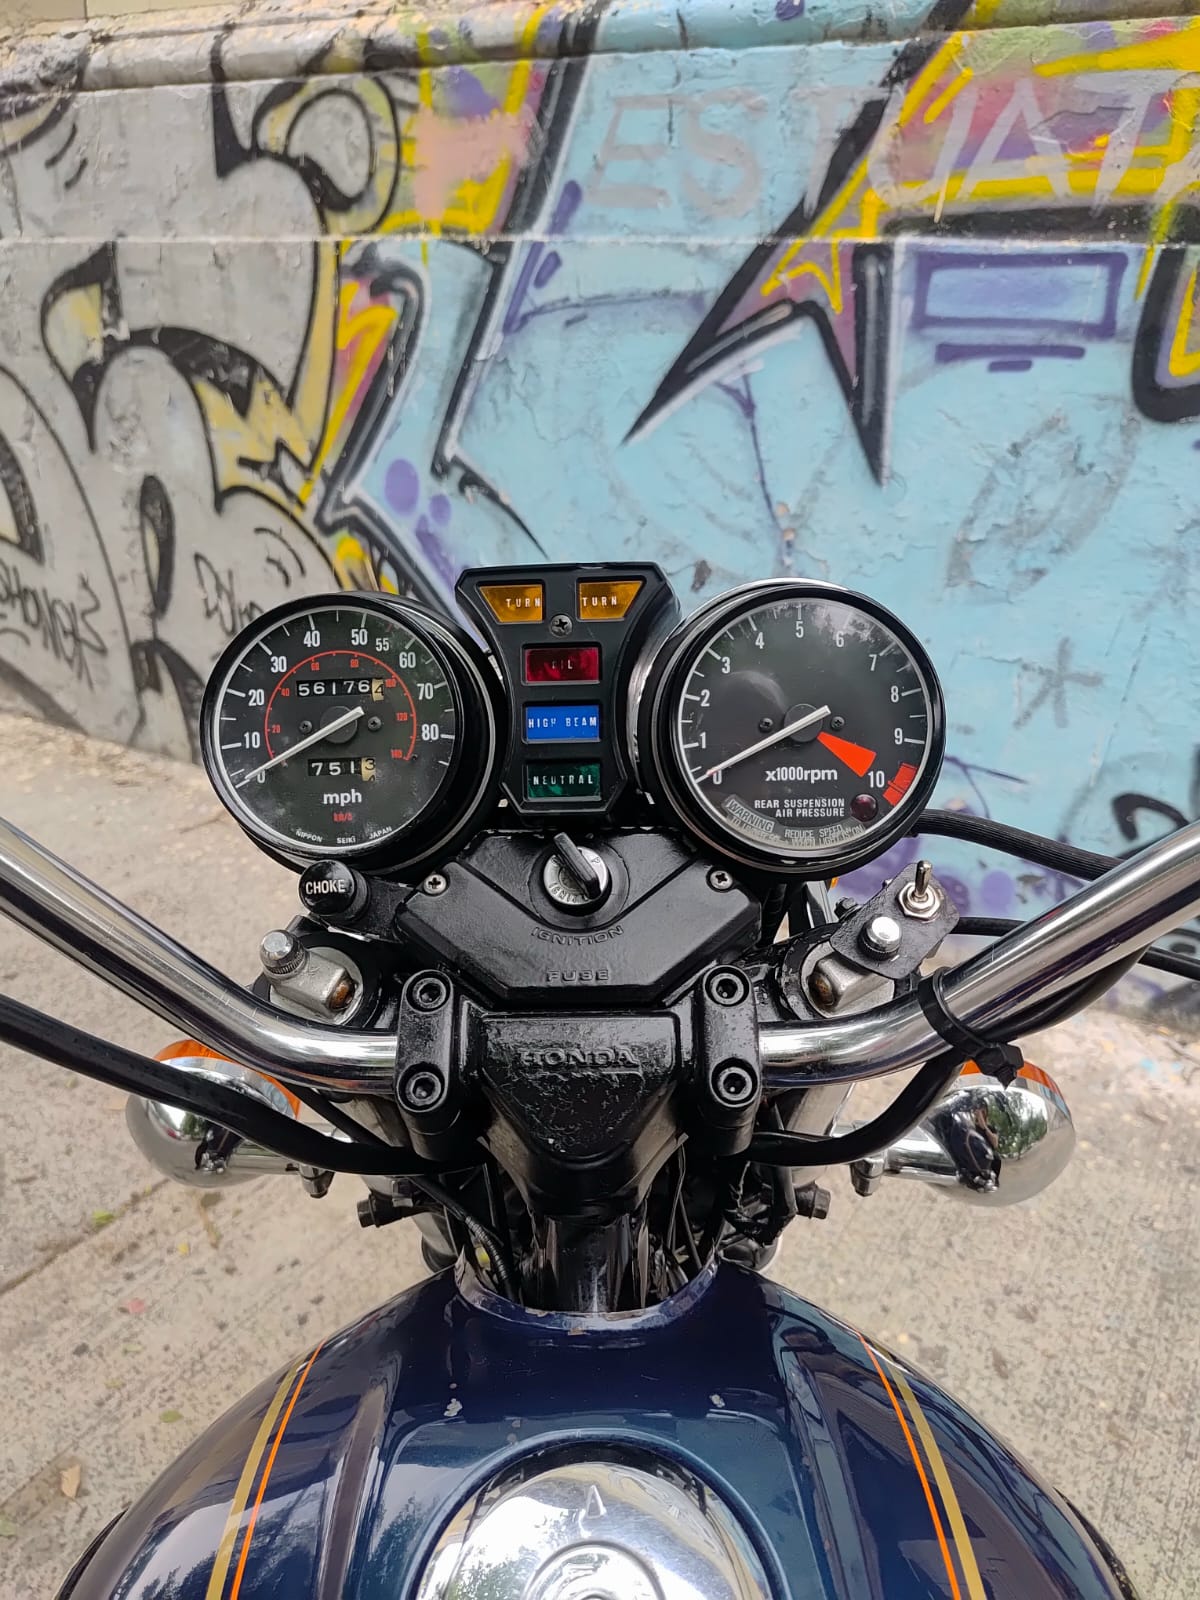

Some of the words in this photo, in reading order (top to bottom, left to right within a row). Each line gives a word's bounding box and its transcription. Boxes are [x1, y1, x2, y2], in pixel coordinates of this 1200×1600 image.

[505, 598, 541, 609] TURN
[582, 596, 617, 607] TURN
[351, 628, 368, 646] 50
[795, 621, 805, 638] 5
[303, 631, 321, 648] 40
[375, 638, 390, 653] 55
[755, 632, 765, 649] 4
[835, 631, 845, 648] 6
[270, 656, 287, 673] 30
[399, 651, 417, 669] 60
[721, 657, 731, 674] 3
[868, 654, 878, 671] 7
[248, 689, 265, 706] 20
[417, 683, 434, 700] 70
[700, 690, 710, 707] 2
[890, 685, 899, 702] 8
[566, 716, 598, 728] BEAM
[243, 731, 261, 749] 10
[421, 723, 440, 741] 80
[699, 732, 707, 748] 1
[894, 728, 903, 745] 9
[533, 774, 594, 786] NEUTRAL
[765, 766, 838, 784] x1000rpm
[868, 771, 885, 789] 10
[323, 788, 362, 807] mph
[754, 799, 780, 809] REAR
[784, 798, 845, 808] SUSPENSION
[728, 800, 774, 833] WARNING
[775, 808, 793, 818] AIR
[796, 808, 845, 817] PRESSURE
[295, 829, 323, 843] NIPPON
[369, 825, 393, 840] JAPAN
[784, 829, 814, 839] REDUCE
[819, 824, 843, 838] SPEED
[305, 880, 346, 895] CHOKE
[531, 924, 624, 946] IGNITION
[546, 969, 609, 982] FUSE
[517, 1046, 640, 1068] HONDA
